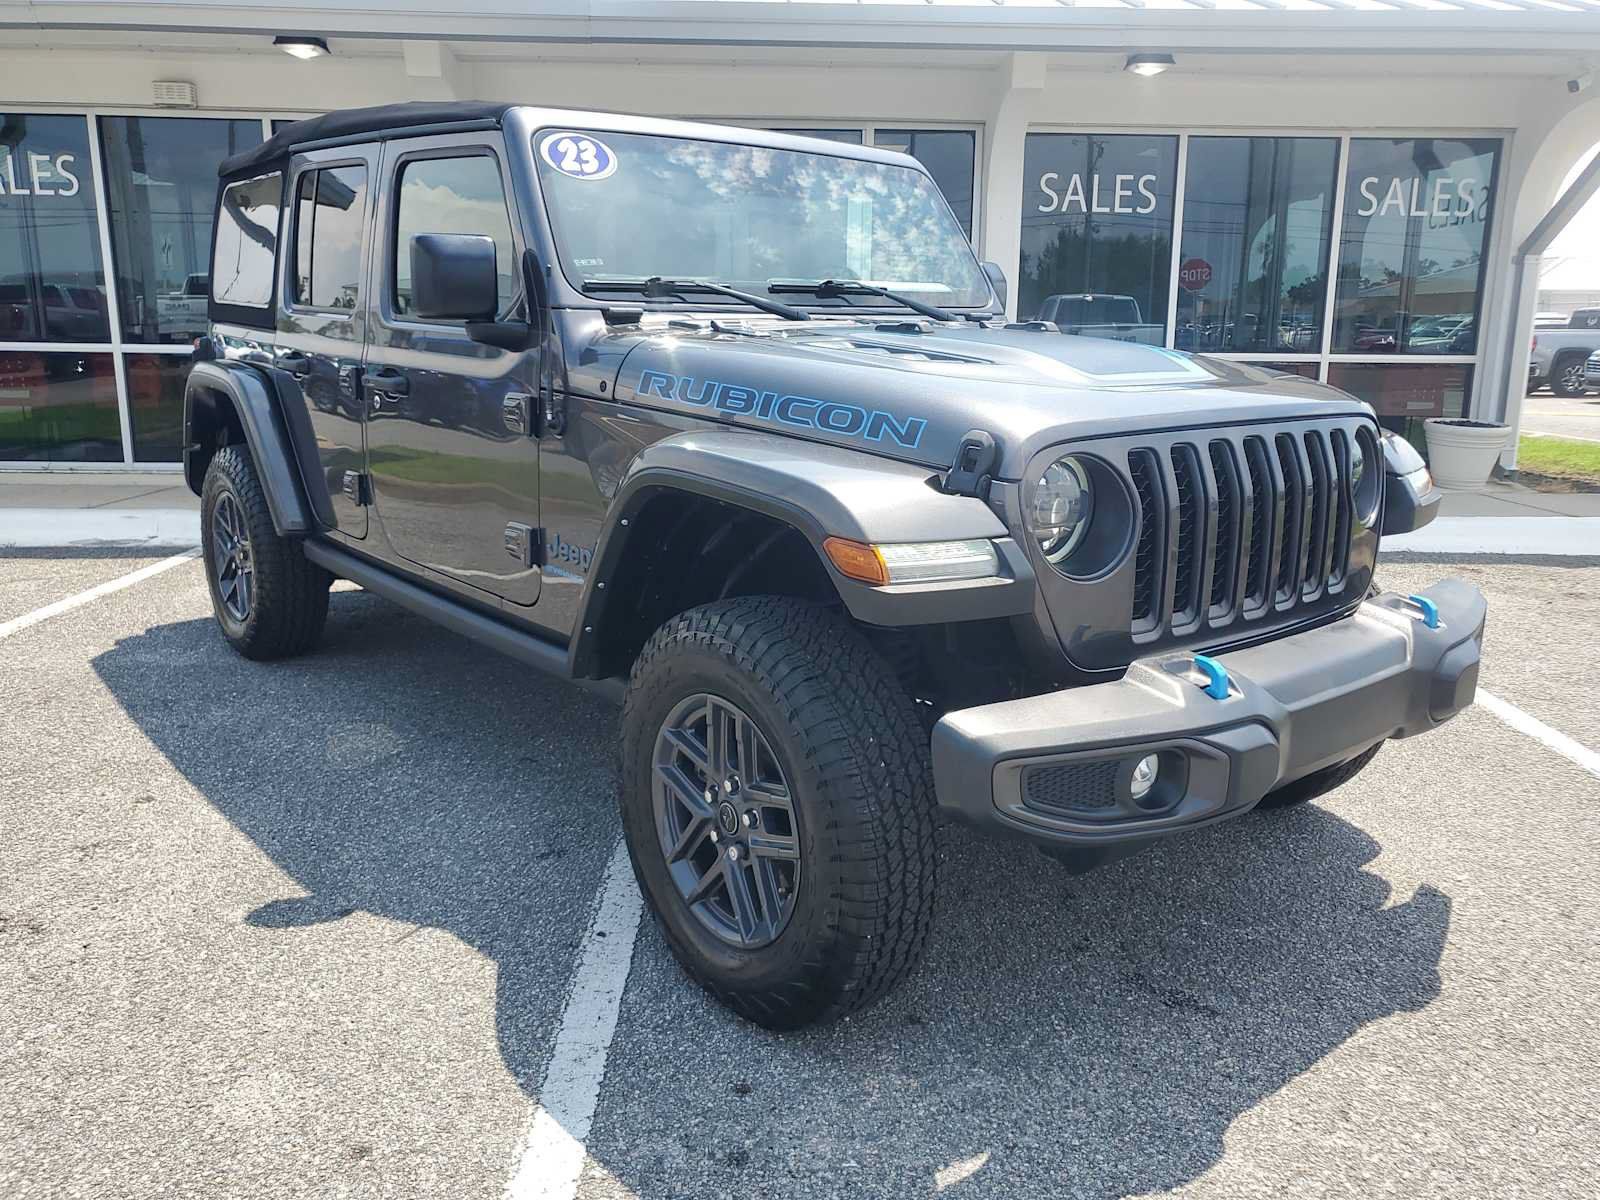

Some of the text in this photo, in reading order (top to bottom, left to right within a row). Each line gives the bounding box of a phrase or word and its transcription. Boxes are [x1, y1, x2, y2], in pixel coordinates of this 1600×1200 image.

[0, 154, 79, 197] LES
[557, 138, 599, 174] 23
[1038, 172, 1157, 214] SALES
[1358, 176, 1477, 217] SALES
[637, 369, 928, 448] RUBICON
[546, 533, 593, 571] Jeep
